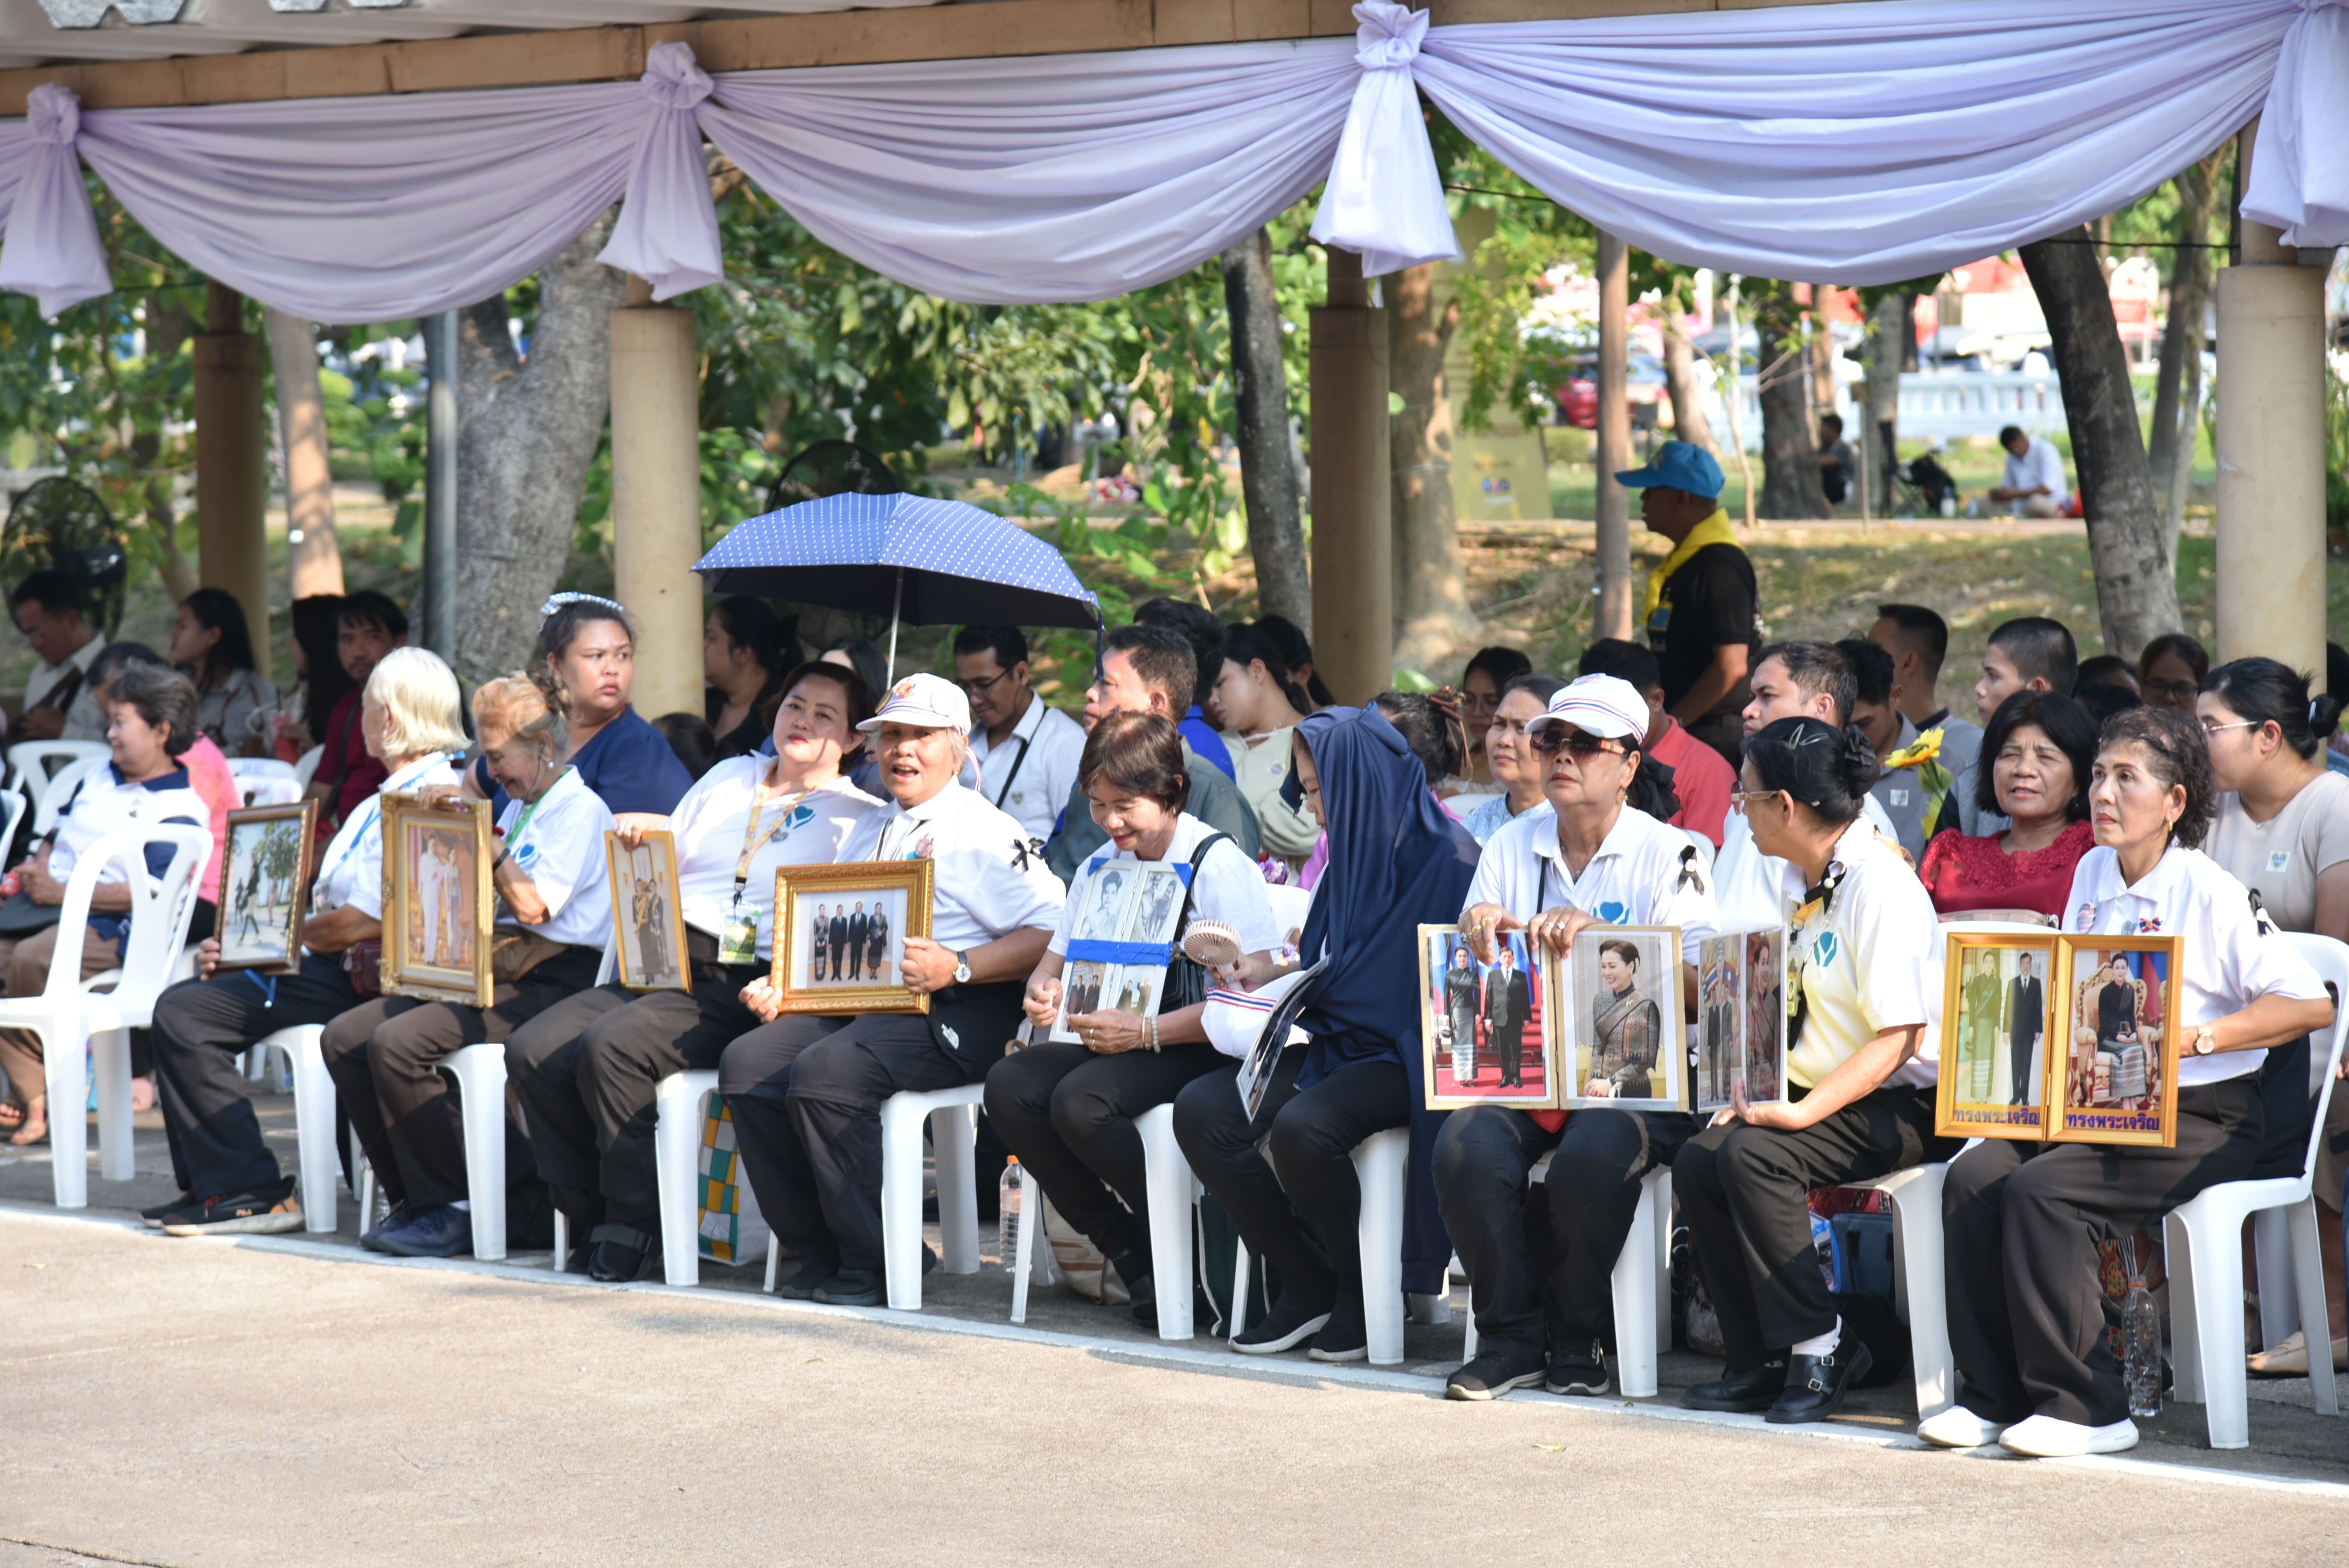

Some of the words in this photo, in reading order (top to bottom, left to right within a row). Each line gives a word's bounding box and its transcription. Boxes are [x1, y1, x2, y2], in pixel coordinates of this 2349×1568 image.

[1954, 1107, 2040, 1125] ทรงพระเจริญ
[2067, 1112, 2160, 1130] ทรงพระเจริญ
